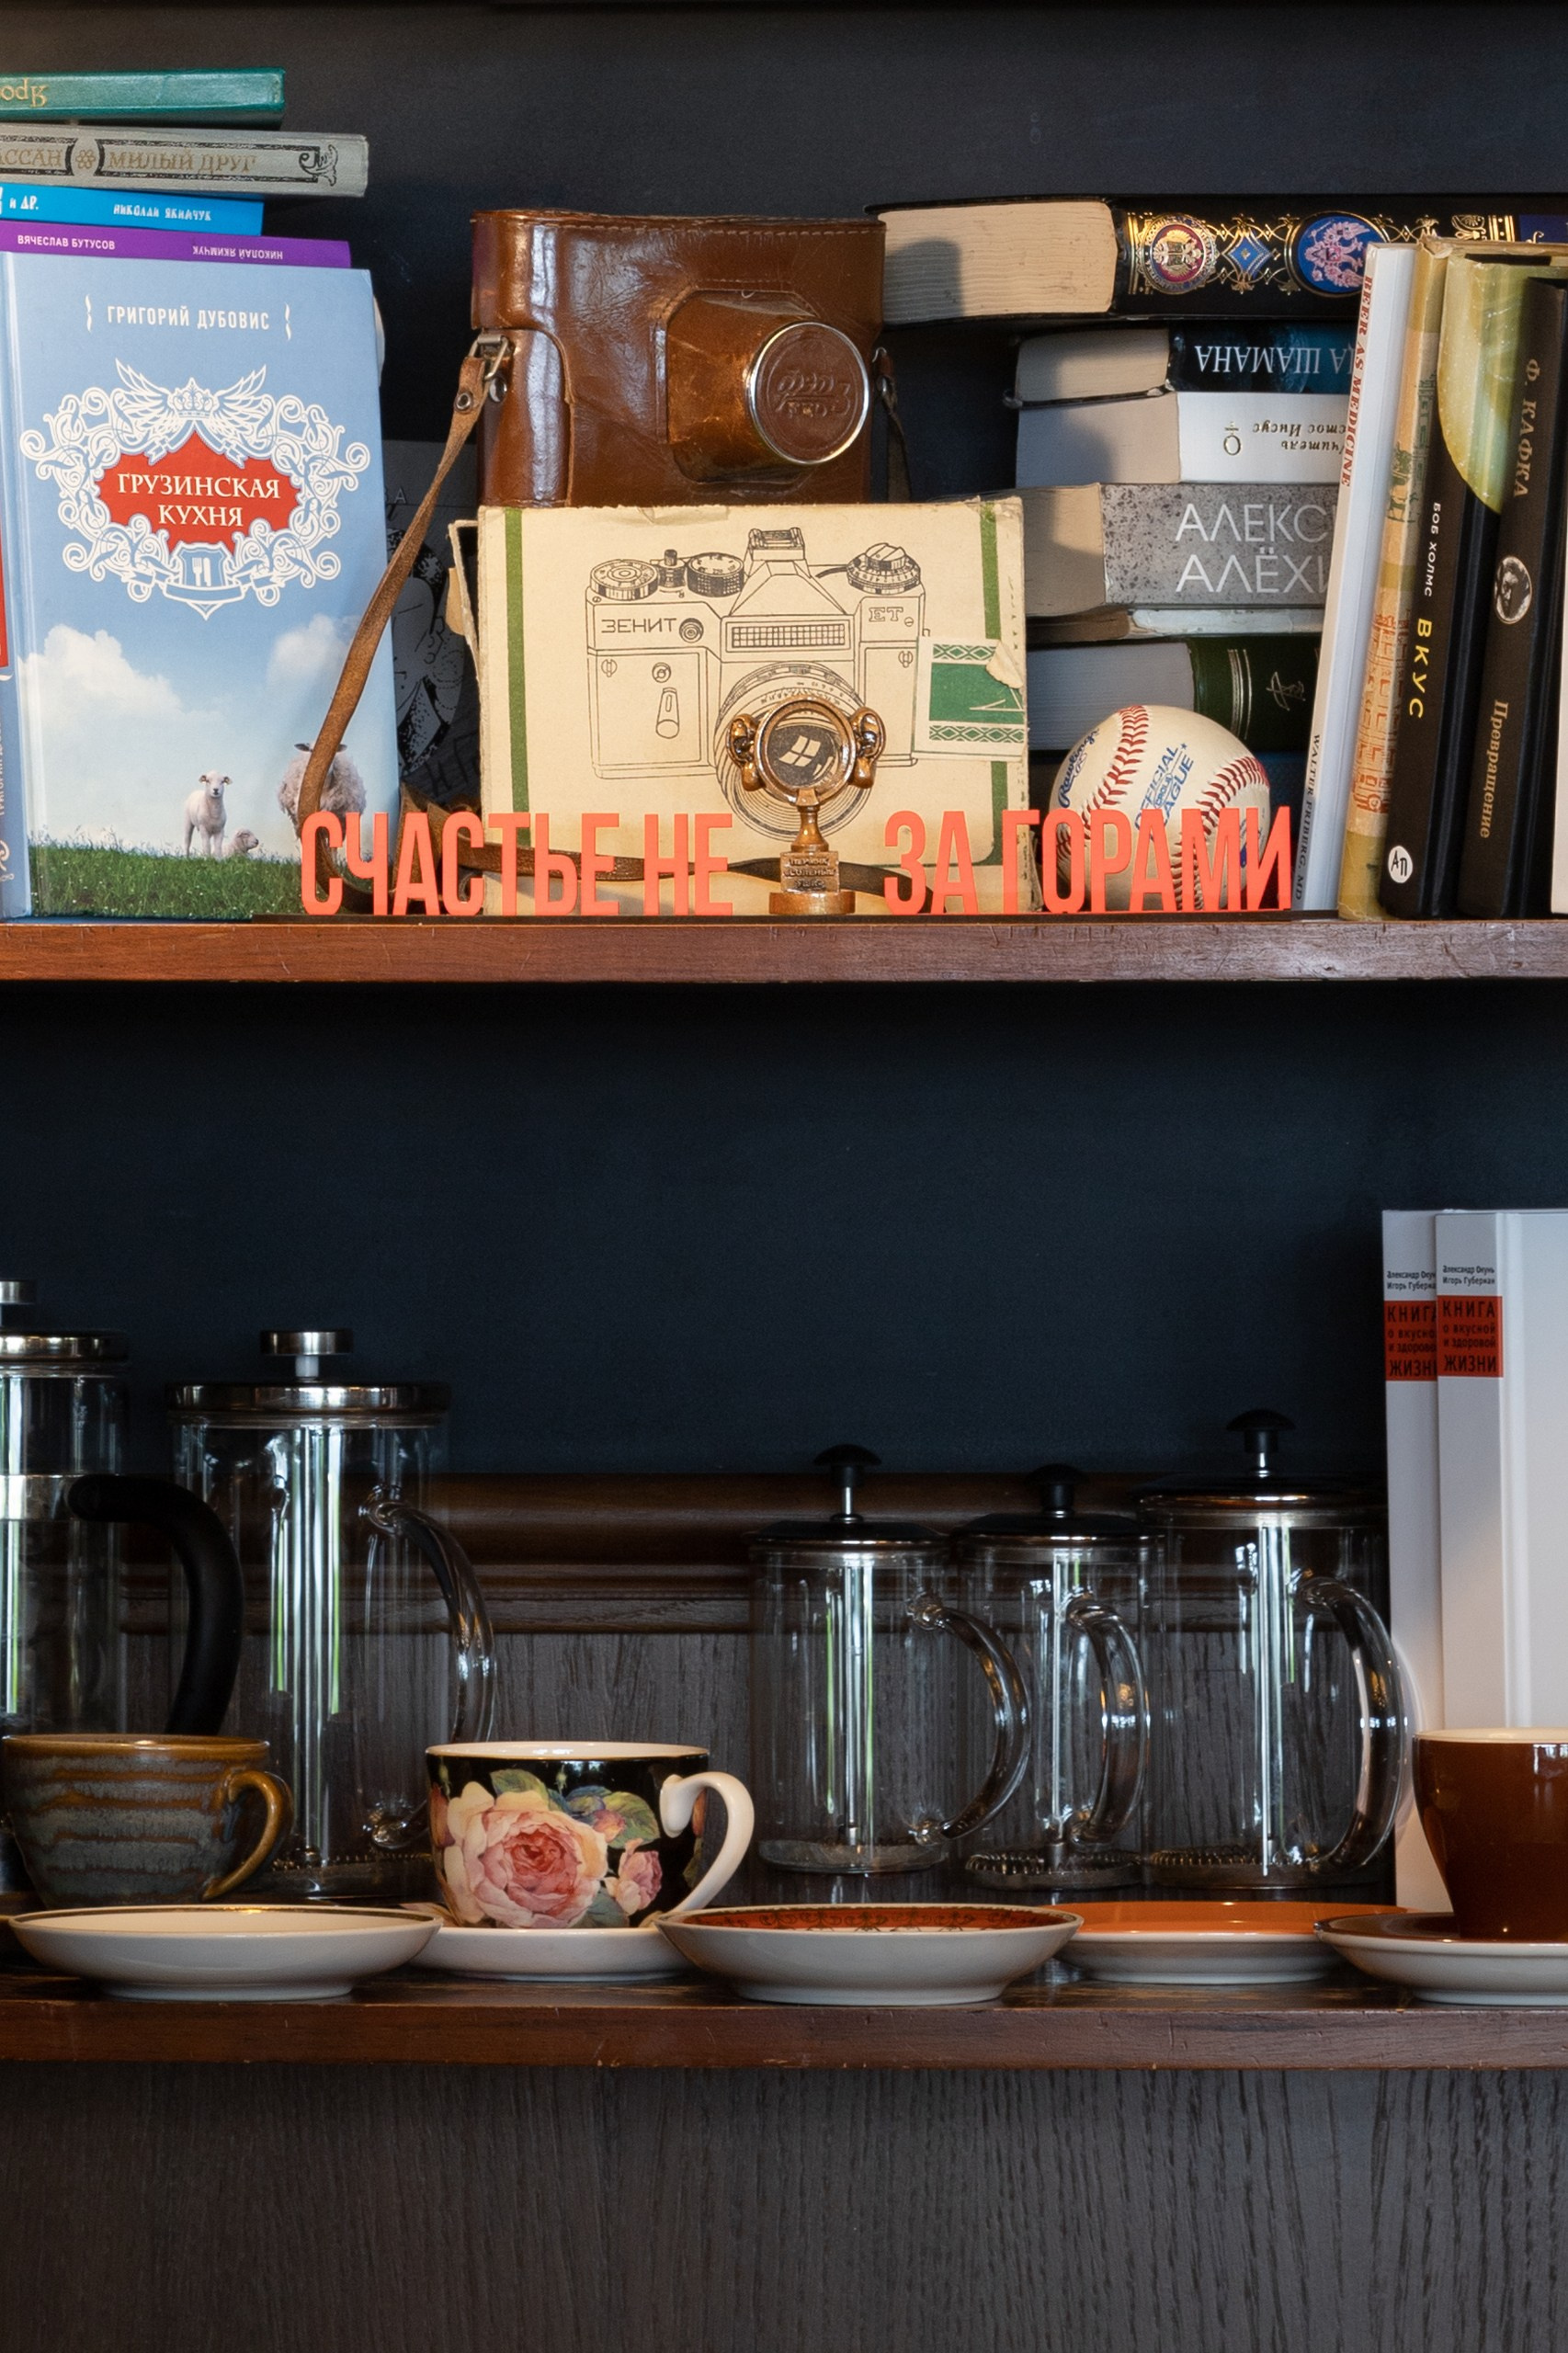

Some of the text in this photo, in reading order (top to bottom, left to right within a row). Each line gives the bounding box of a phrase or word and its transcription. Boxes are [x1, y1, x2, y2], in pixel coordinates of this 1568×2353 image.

[108, 149, 193, 171] МИЛЫЙ
[199, 153, 257, 175] ДРУГ
[17, 234, 283, 261] ВЯЧЕСЛАВ БУТУСОВ НИКОЛАЙ ЯКИМЧУК
[108, 305, 270, 330] ГРИГОРИЙ ДУБОВИС
[1195, 345, 1322, 374] ШАМАНА
[1341, 276, 1373, 487] BEER AS MEDICINE
[1252, 420, 1301, 437] Иисус
[1513, 358, 1541, 498] Ф. КАФКА
[117, 472, 280, 499] ГРУЗИНСКАЯ
[157, 505, 244, 527] КУХНЯ
[1175, 503, 1336, 543] АЛЕКС
[1425, 502, 1441, 597] БОБ ХОЛМС
[601, 618, 677, 633] ЗЕНИТ
[1408, 618, 1433, 719] ВКУС
[1058, 728, 1099, 808] Rawlings
[1480, 699, 1509, 839] Превращение
[1295, 733, 1321, 901] WALTER FRIBERG, MD
[301, 811, 619, 916] СЧАСТЬЕ
[643, 813, 733, 916] НЕ
[883, 810, 979, 915] ЗА
[1002, 806, 1292, 914] ГОРАМИ
[1442, 1277, 1495, 1287] Игорь Губерман
[1476, 1266, 1494, 1276] Окунь
[1387, 1282, 1406, 1291] Игорь
[1442, 1301, 1495, 1318] КНИГА
[1388, 1329, 1394, 1338] о
[1443, 1322, 1495, 1336] о вкусной
[1452, 1336, 1496, 1350] здоровой
[1389, 1359, 1437, 1376] ЖИЗН
[1444, 1355, 1496, 1371] ЖИЗНИ
